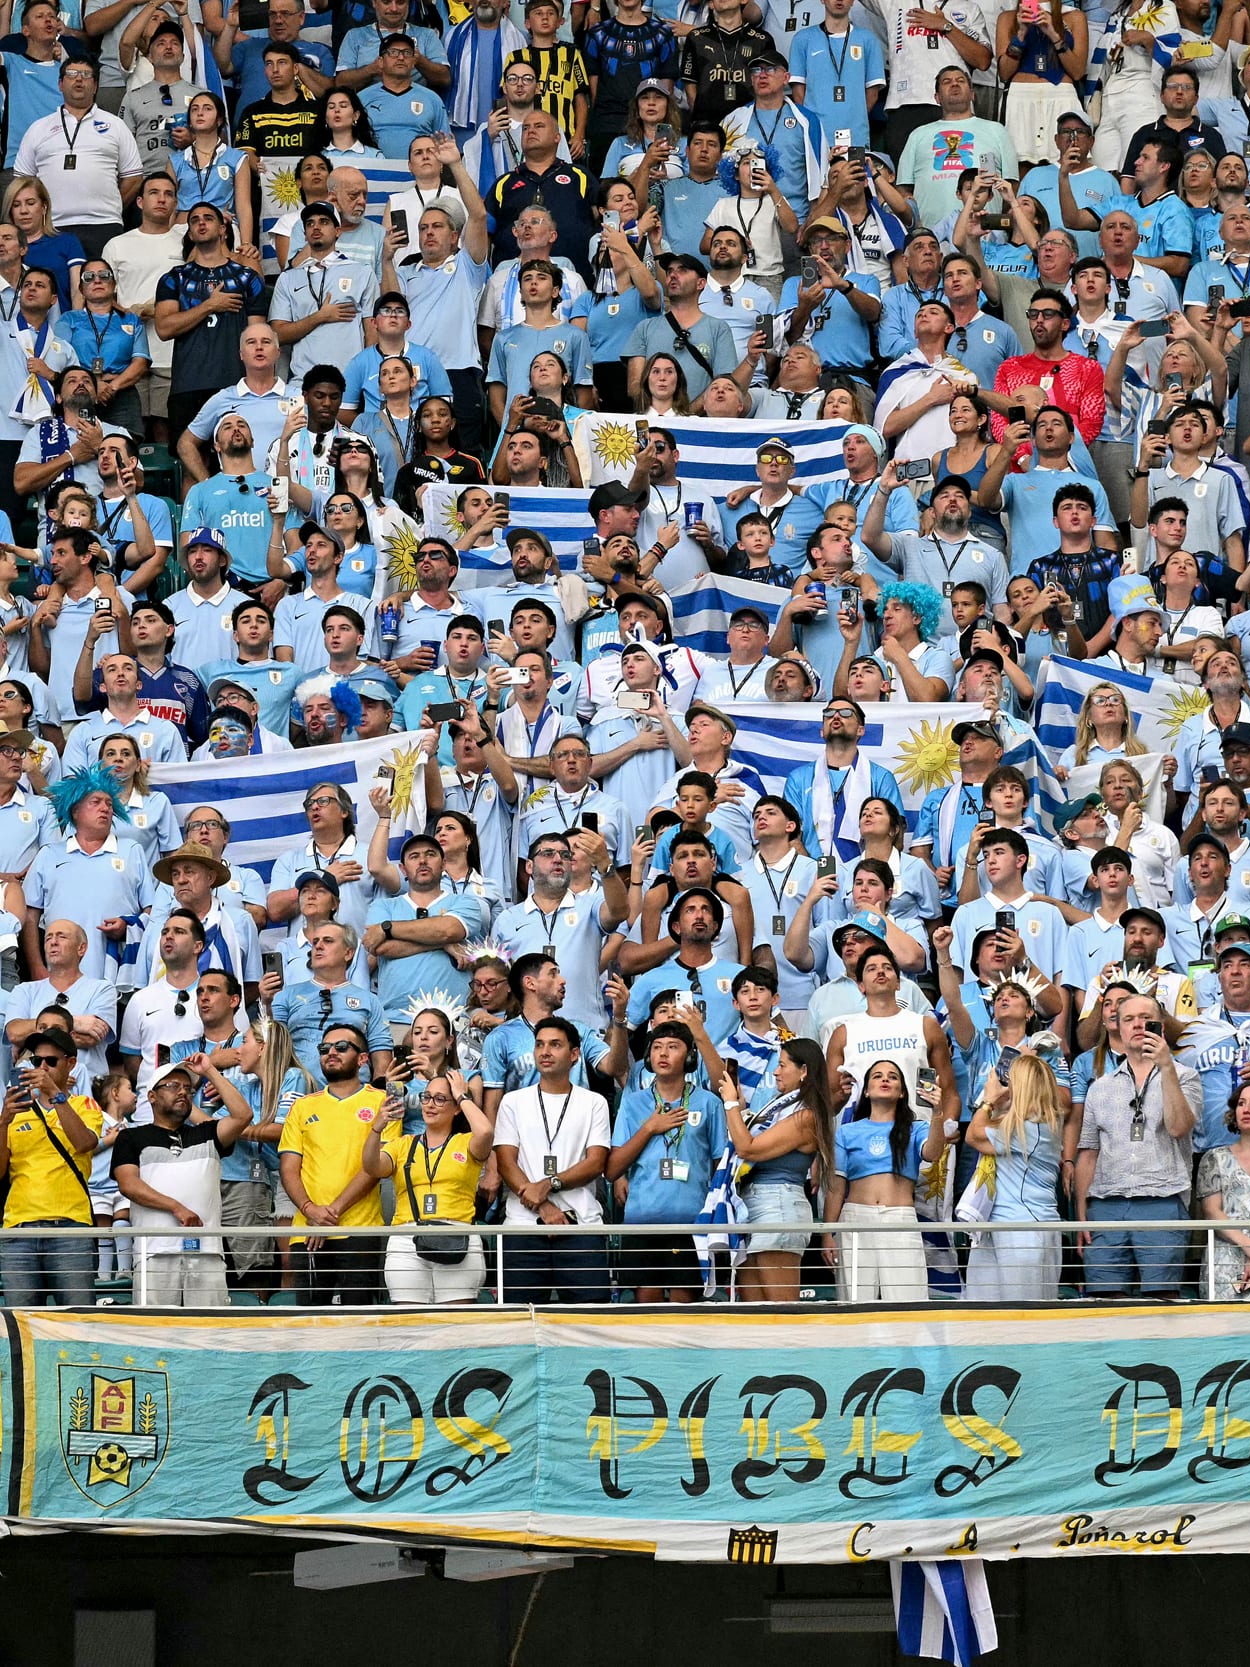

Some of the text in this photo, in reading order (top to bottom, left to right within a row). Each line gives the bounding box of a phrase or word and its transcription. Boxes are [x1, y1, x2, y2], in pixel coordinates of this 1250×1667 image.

[709, 64, 746, 83] antel
[265, 130, 303, 148] antel
[221, 510, 265, 529] antel
[318, 1011, 330, 1031] 7
[857, 1038, 918, 1054] URUGUAY
[101, 1385, 127, 1430] AUF
[241, 1367, 515, 1507] LOS
[582, 1360, 1024, 1502] PIBES
[1056, 1514, 1196, 1551] Peñarol
